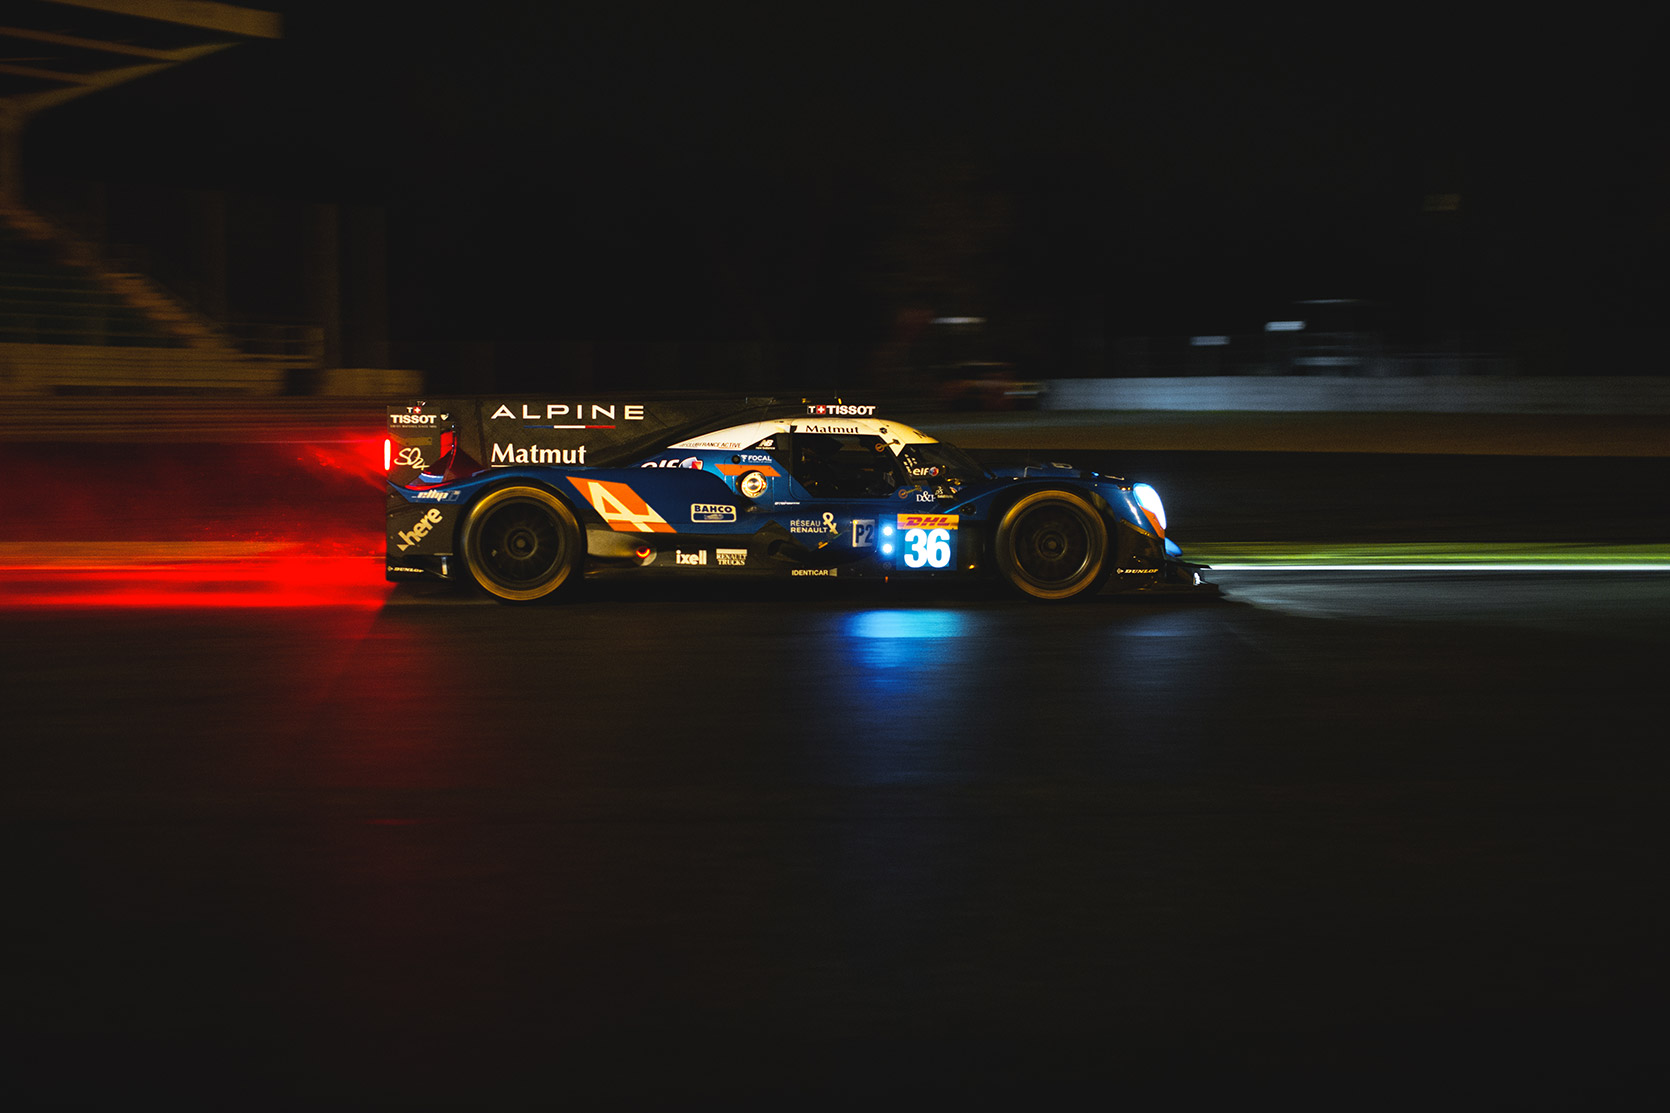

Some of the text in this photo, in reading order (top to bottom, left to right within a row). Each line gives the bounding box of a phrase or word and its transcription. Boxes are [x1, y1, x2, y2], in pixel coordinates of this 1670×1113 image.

[491, 404, 645, 420] ALPINE
[825, 405, 876, 416] TISSOT
[390, 414, 437, 424] TISSOT
[806, 424, 859, 434] Matmut
[491, 443, 587, 466] Matmut
[912, 467, 930, 476] elf
[694, 504, 733, 513] BAHCO
[790, 518, 821, 527] RÉSEAU
[905, 516, 950, 526] DHL
[397, 508, 443, 547] here
[855, 523, 874, 543] P2
[904, 528, 951, 568] 36
[675, 549, 707, 565] ixell
